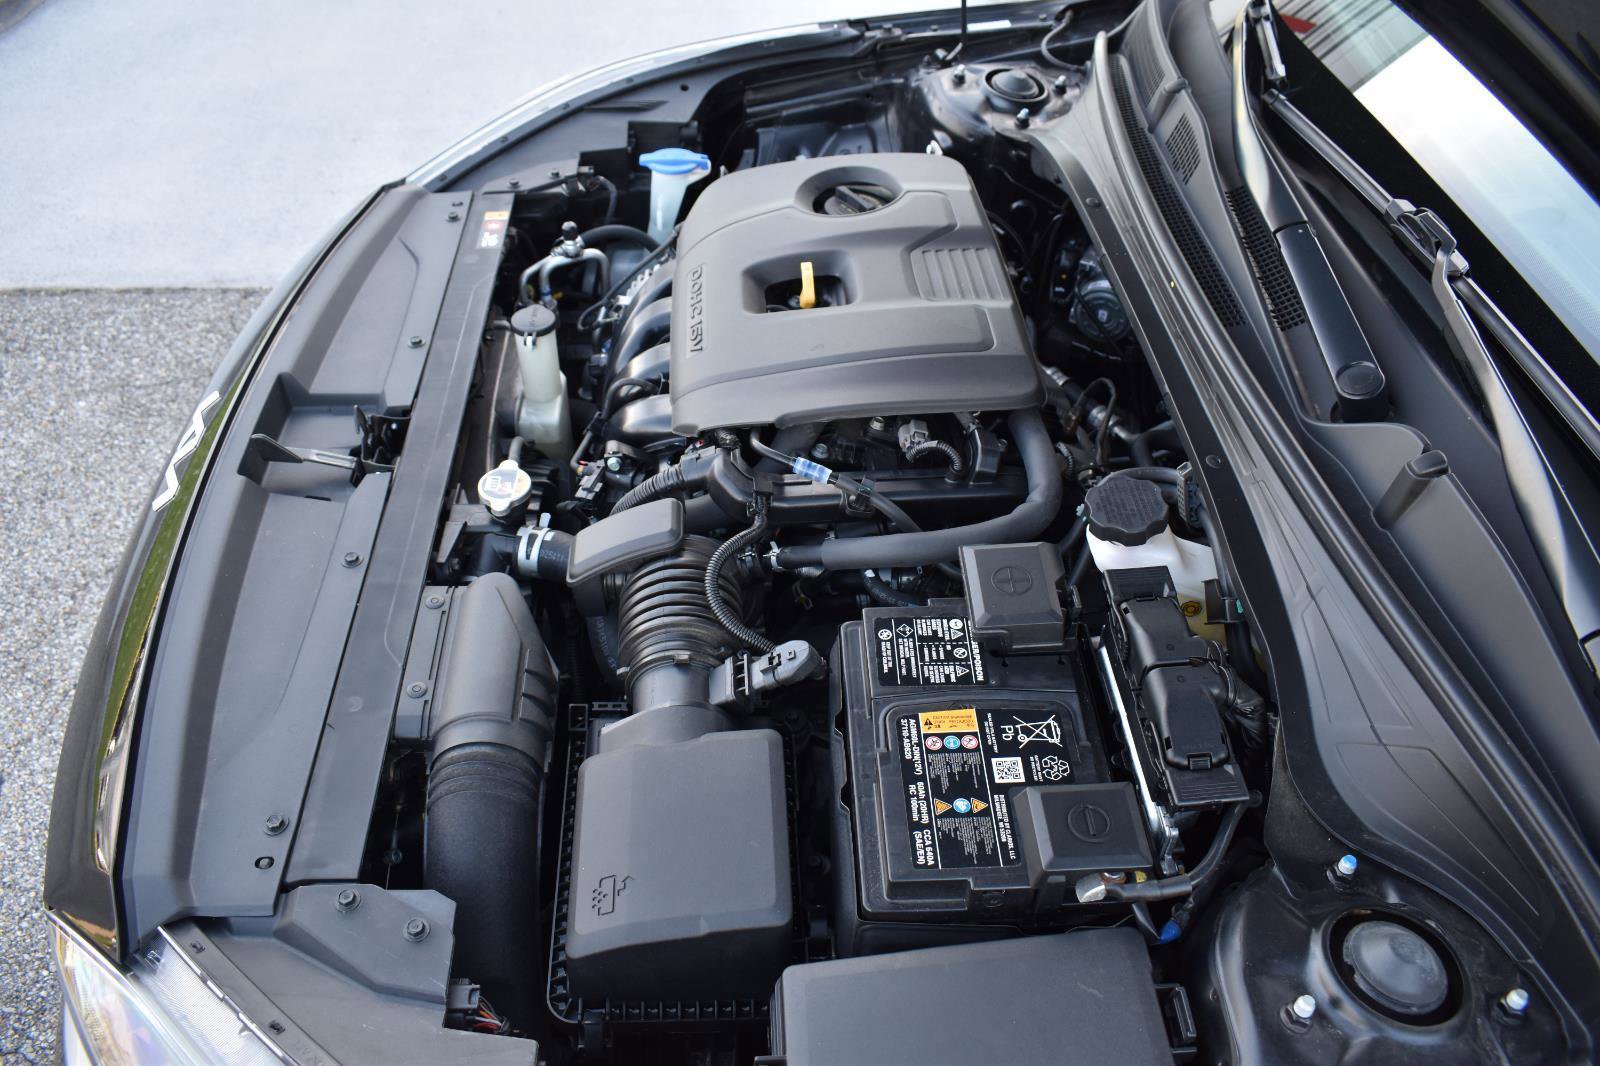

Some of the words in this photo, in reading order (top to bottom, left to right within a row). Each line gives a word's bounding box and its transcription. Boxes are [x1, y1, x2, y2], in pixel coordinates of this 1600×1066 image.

[689, 264, 703, 319] DOHC
[901, 718, 912, 760] 37110-AB620
[1000, 725, 1014, 741] Pb
[908, 784, 917, 795] RC
[916, 782, 925, 801] 60Ah
[910, 796, 919, 821] 100min
[920, 801, 930, 824] (20HR)
[912, 831, 926, 865] (SAE/EN)
[923, 829, 932, 846] CCA
[926, 846, 935, 866] 640A
